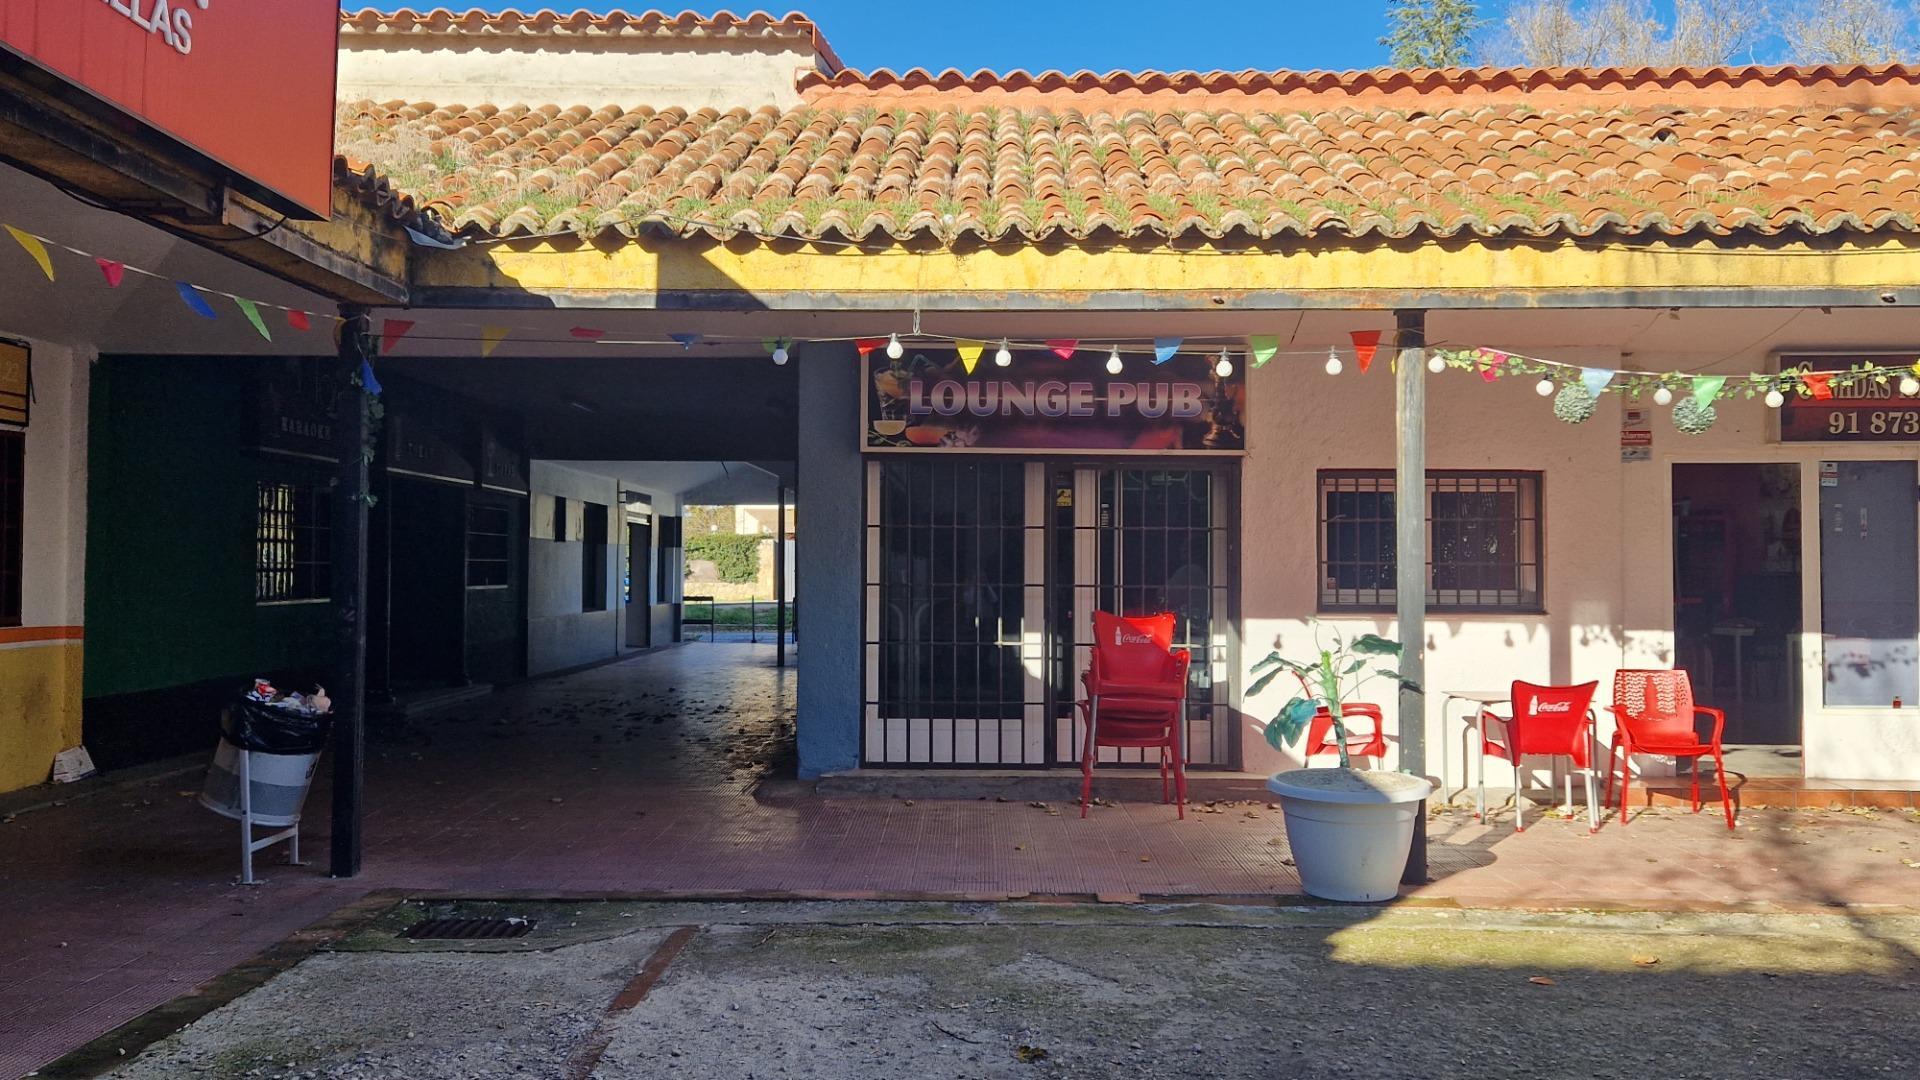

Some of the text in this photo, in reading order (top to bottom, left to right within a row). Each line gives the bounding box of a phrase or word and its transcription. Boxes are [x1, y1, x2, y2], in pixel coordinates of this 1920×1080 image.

[910, 380, 1203, 418] LOUNGE PUB
[1828, 411, 1920, 434] 91 873
